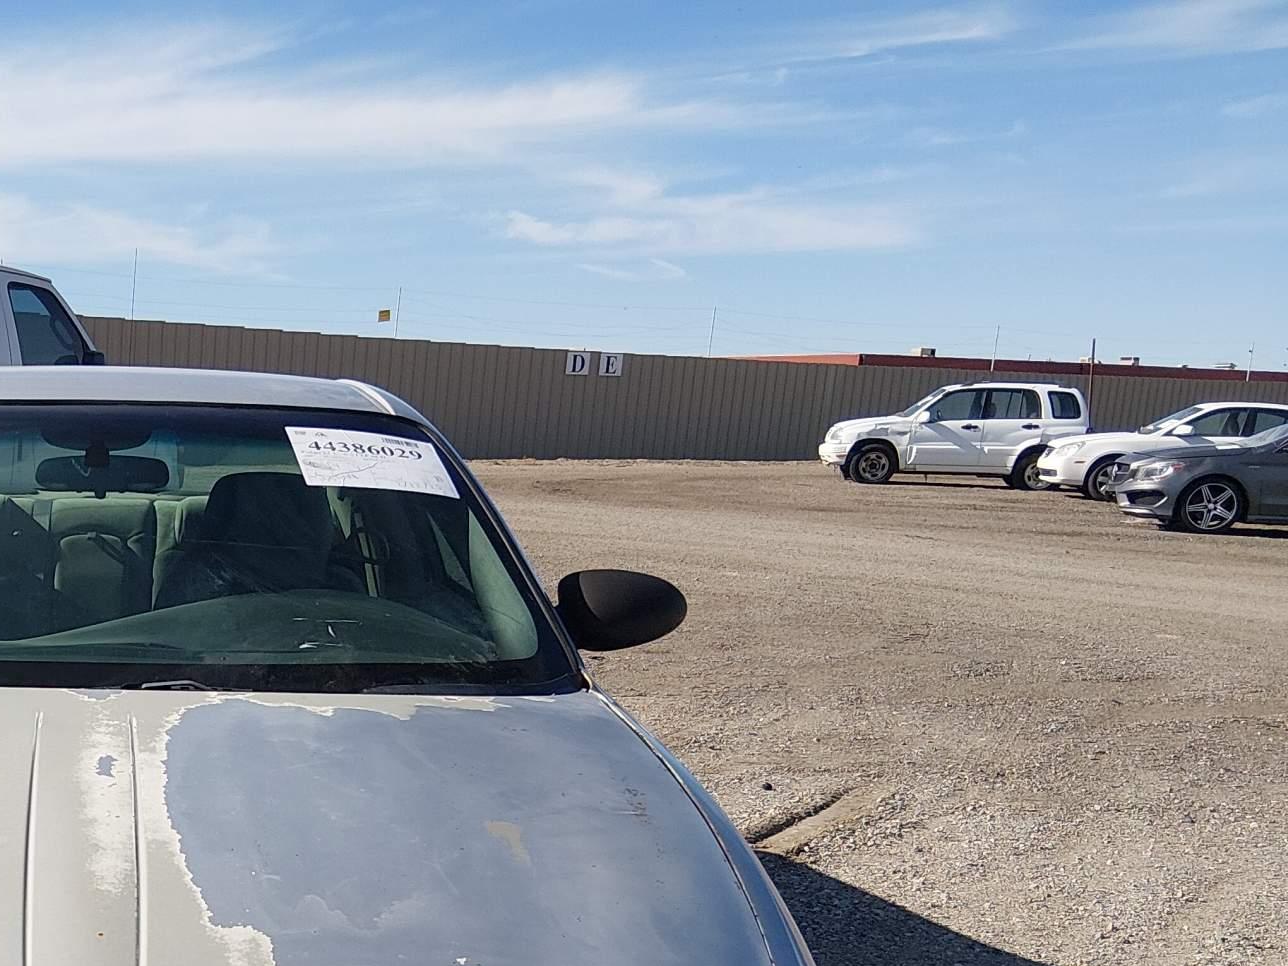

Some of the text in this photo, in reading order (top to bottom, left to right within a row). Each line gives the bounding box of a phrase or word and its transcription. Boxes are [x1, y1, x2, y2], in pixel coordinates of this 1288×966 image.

[569, 354, 585, 373] D
[604, 355, 618, 374] E
[308, 440, 423, 461] 44386029
